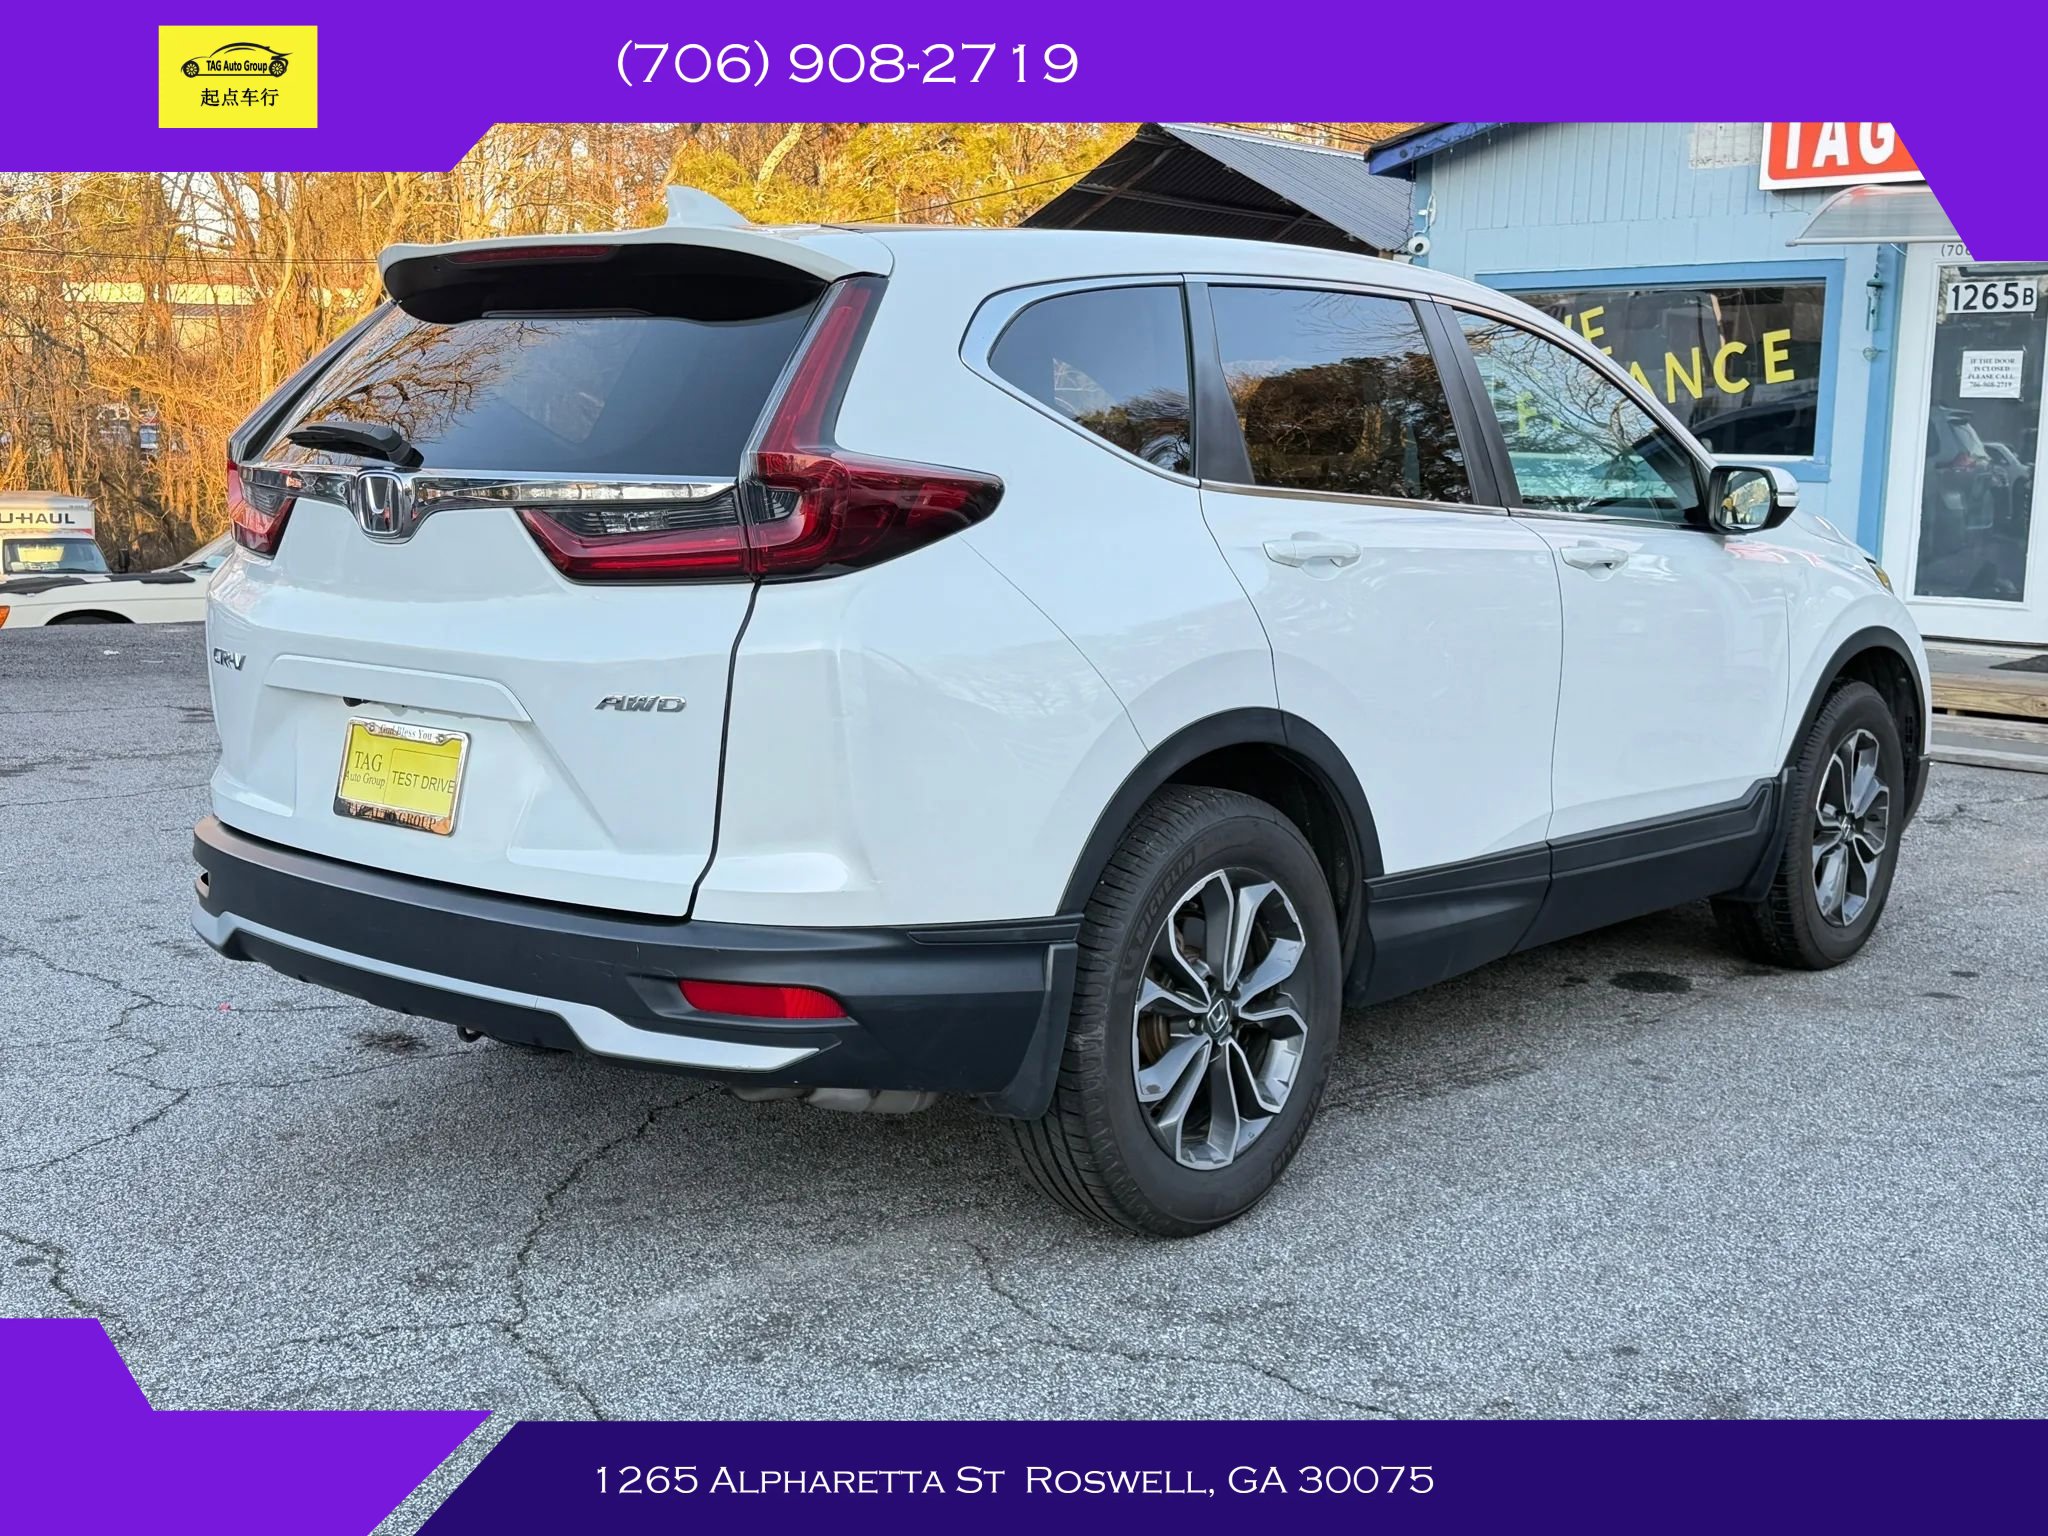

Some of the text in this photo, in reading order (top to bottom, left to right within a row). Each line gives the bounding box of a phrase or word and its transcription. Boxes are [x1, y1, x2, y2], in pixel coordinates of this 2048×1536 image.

[0, 513, 76, 525] U-HAUL
[213, 646, 247, 671] CR-V
[594, 694, 687, 713] AWD
[418, 729, 433, 741] You
[355, 751, 383, 773] TAG
[345, 770, 386, 789] Auto Group
[392, 770, 457, 794] TEST DRIVE
[399, 811, 437, 831] GROUP
